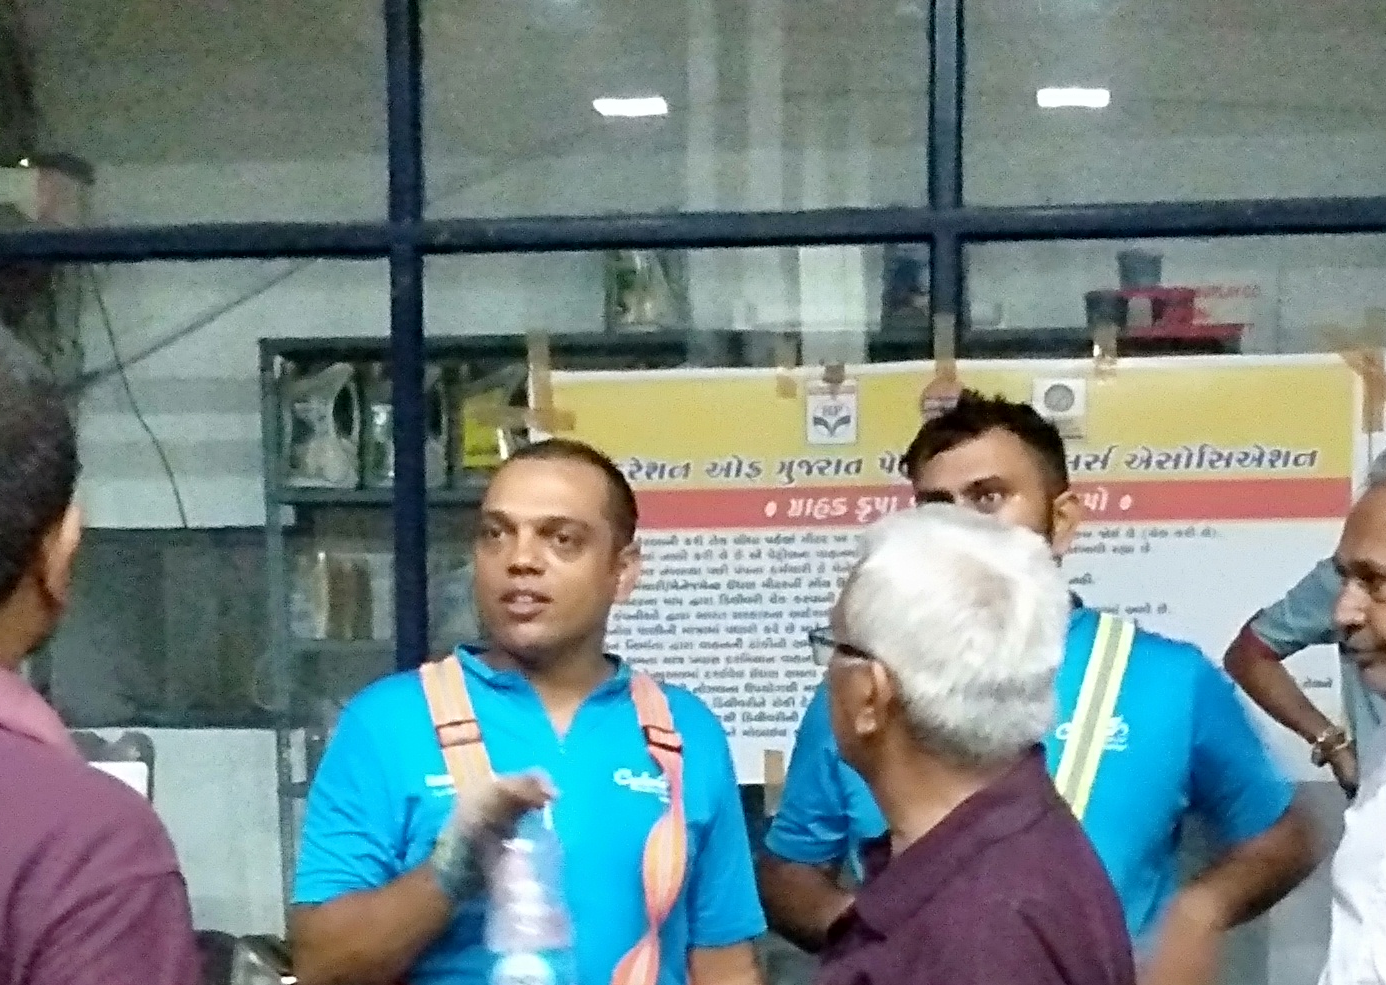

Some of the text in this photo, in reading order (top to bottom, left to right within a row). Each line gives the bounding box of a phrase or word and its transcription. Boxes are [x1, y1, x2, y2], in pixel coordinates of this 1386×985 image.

[624, 456, 691, 480] રેશન
[777, 458, 863, 485] ગુજરાત
[1124, 443, 1319, 471] એસોસિએશન
